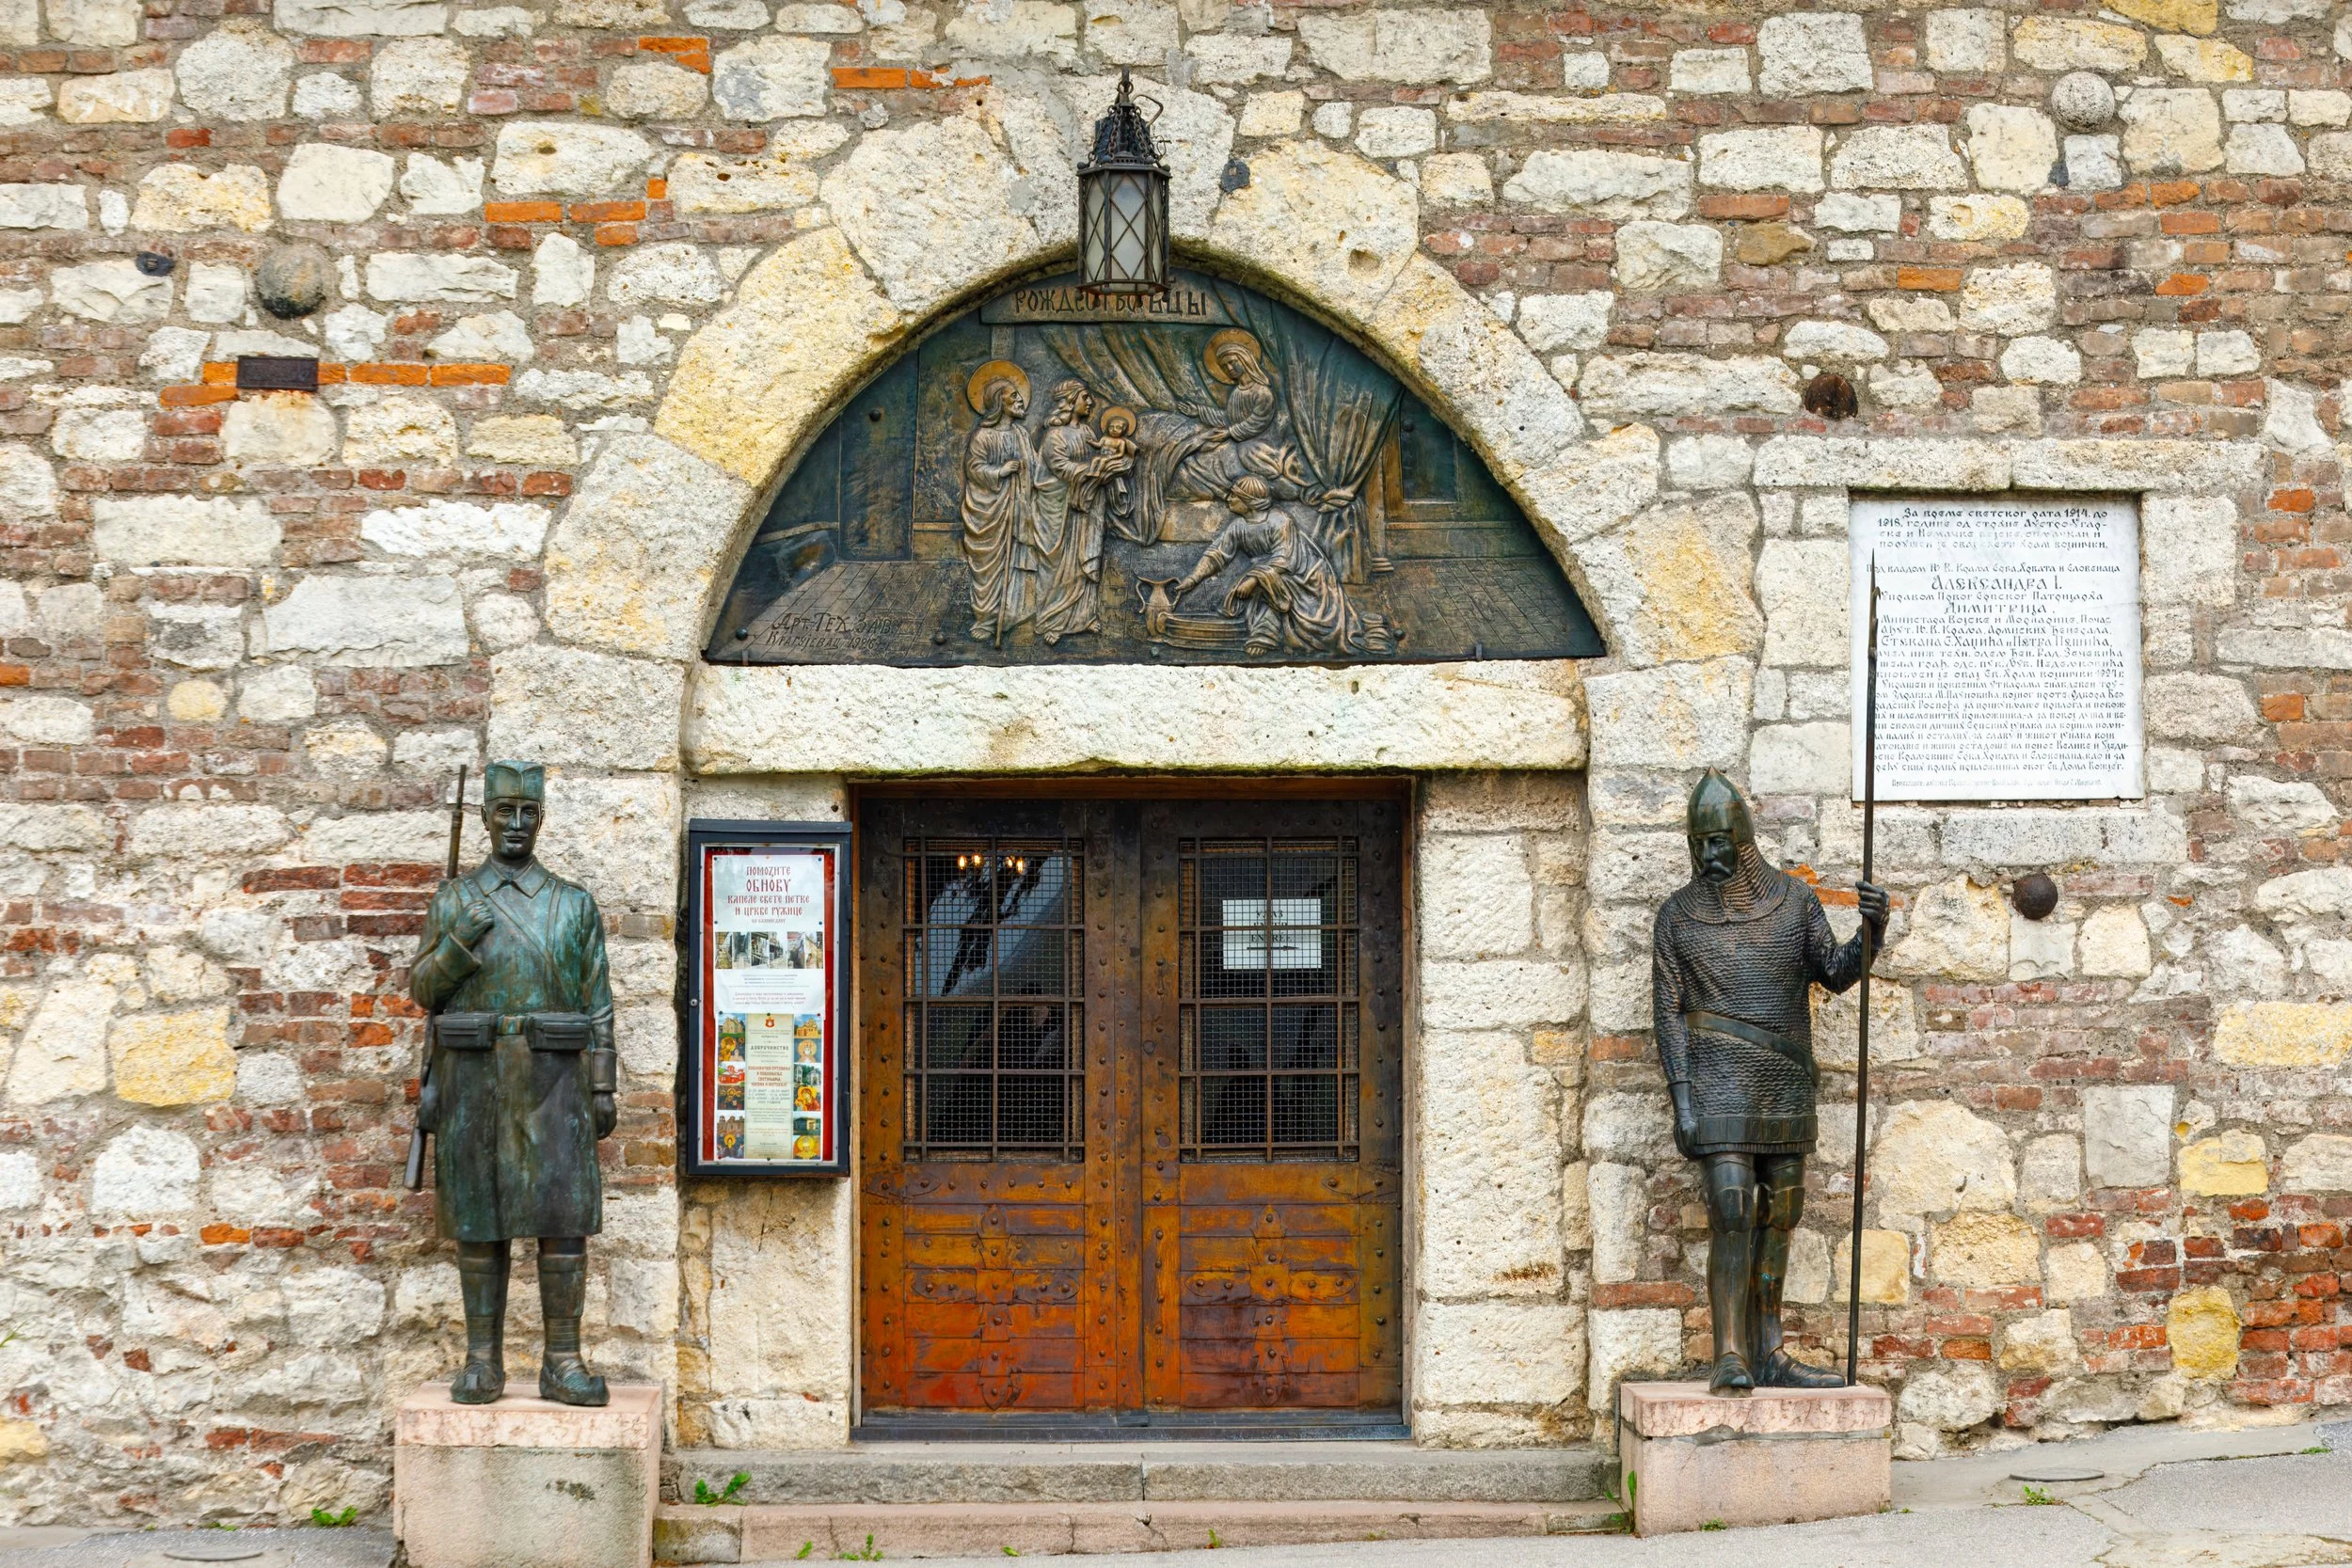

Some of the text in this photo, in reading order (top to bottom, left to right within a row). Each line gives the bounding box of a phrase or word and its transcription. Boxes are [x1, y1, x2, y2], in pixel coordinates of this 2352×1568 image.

[1923, 511, 1963, 520] време
[2032, 511, 2062, 520] рата
[2064, 508, 2090, 517] 1914.
[1878, 517, 1903, 528] 1918.
[2068, 562, 2121, 575] Словенаца
[1977, 591, 2027, 603] Српског
[1882, 614, 1945, 626] Министара
[1948, 614, 1990, 626] Војске
[746, 879, 791, 893] ОБНОВУ
[1251, 932, 1293, 942] ENRÉE
